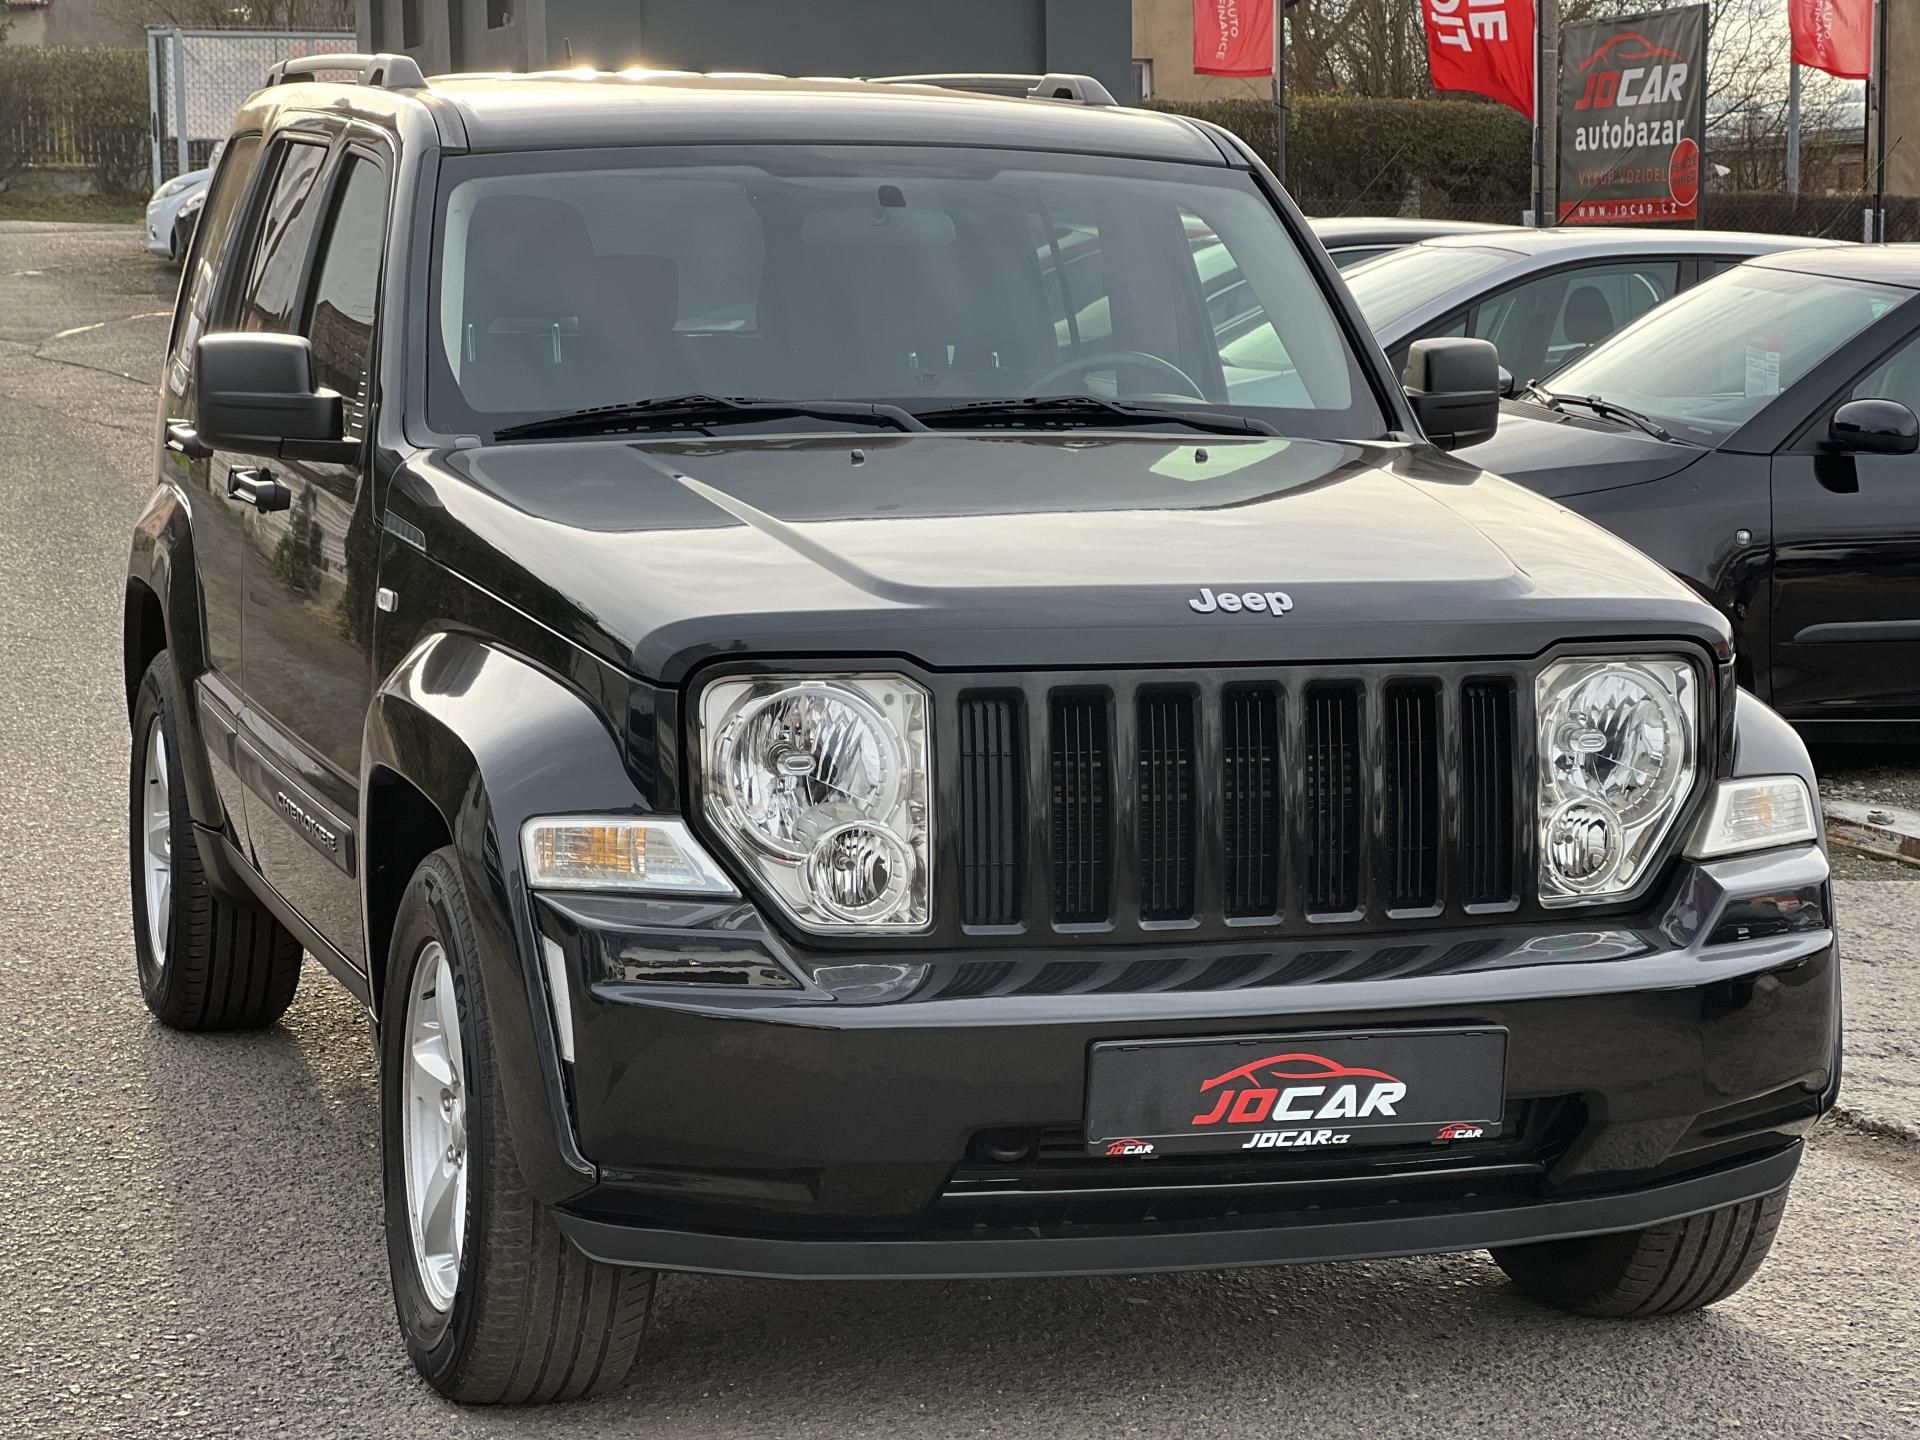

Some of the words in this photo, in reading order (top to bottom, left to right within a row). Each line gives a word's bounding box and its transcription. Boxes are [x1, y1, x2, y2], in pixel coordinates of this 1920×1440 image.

[1823, 0, 1834, 40] AUTO
[1575, 63, 1688, 110] JOCAR
[1575, 116, 1685, 151] autobazar
[1619, 167, 1667, 184] VOZIDEL
[1188, 587, 1294, 617] Jeep
[1191, 1081, 1407, 1125] JOCAR
[1105, 1143, 1155, 1156] JOCAR
[1436, 1126, 1484, 1141] JOCAR
